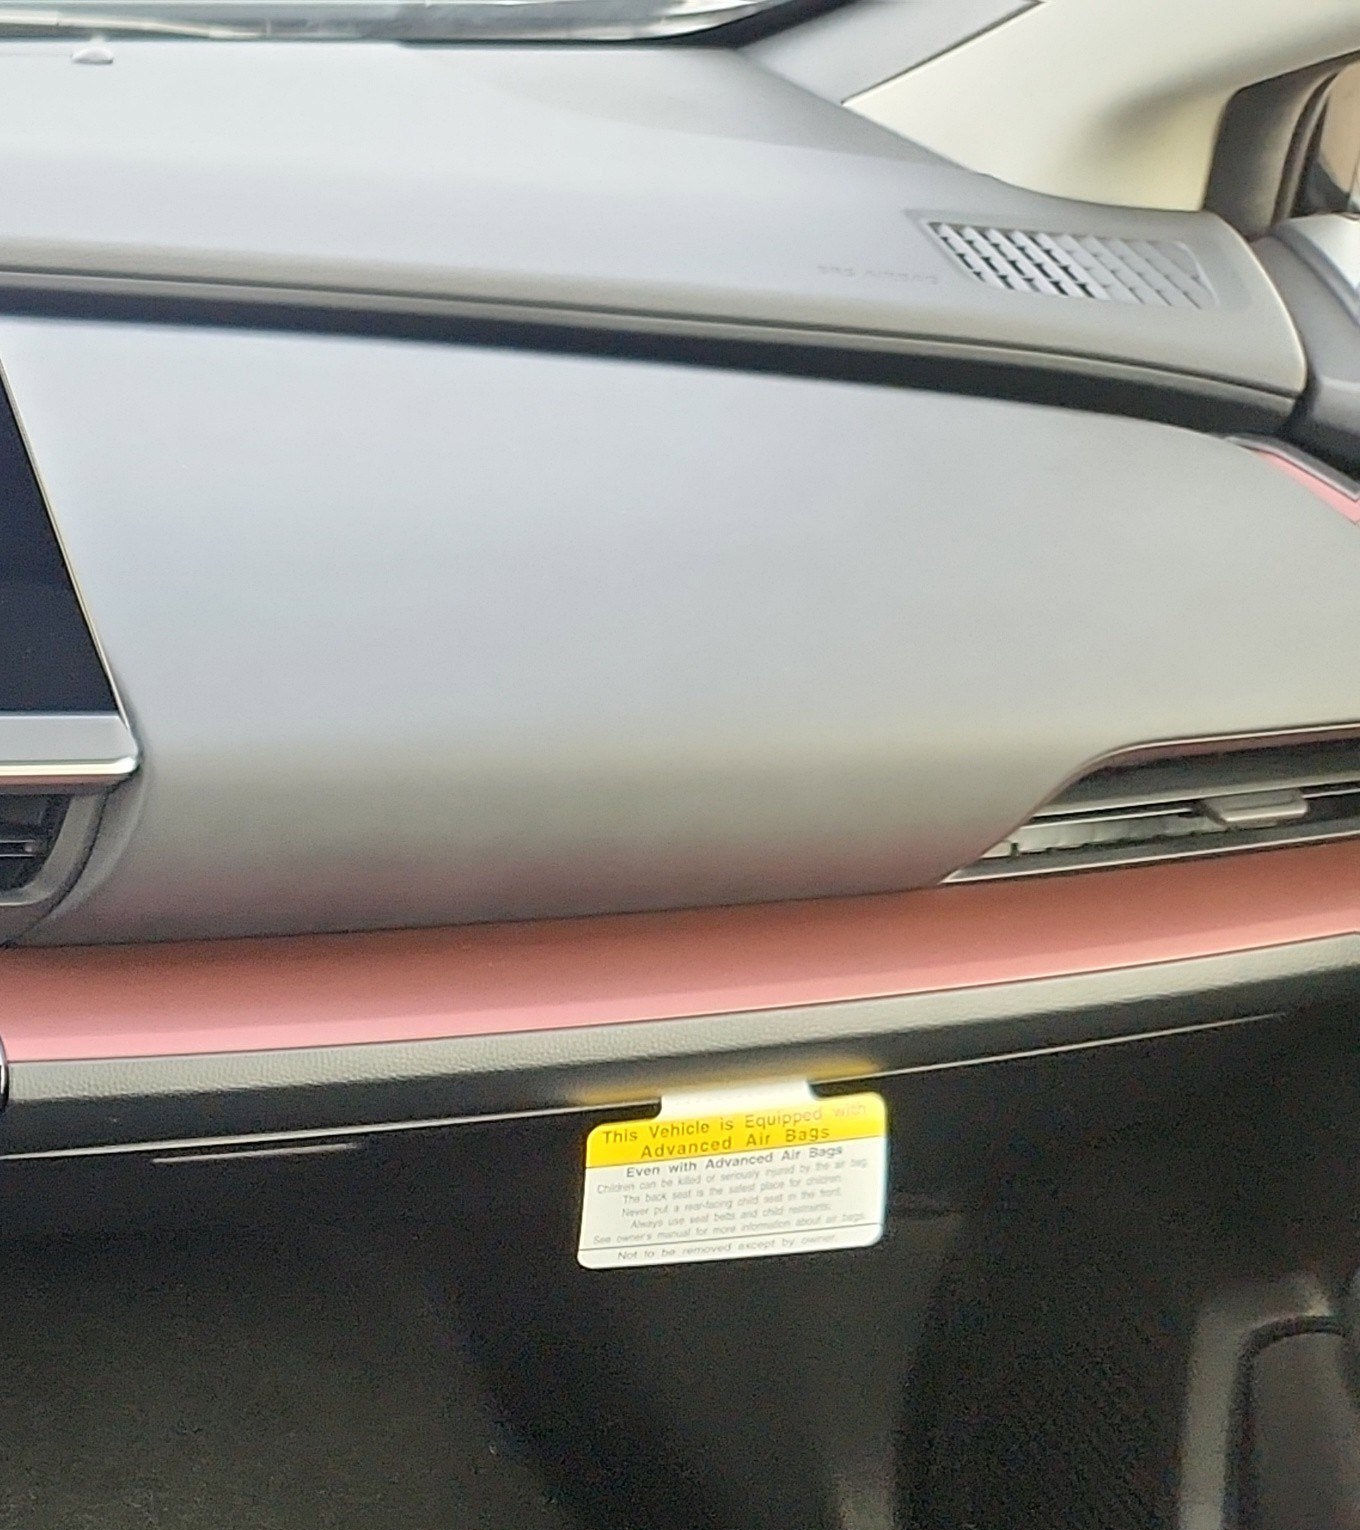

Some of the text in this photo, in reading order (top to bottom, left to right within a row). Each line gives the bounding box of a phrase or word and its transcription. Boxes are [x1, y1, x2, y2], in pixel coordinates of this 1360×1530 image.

[603, 1102, 868, 1145] This Vehicle is Equipped with
[641, 1127, 831, 1160] Advanced Air Bags
[626, 1146, 843, 1178] Even with Advanced Air Bags
[618, 1250, 638, 1260] Not
